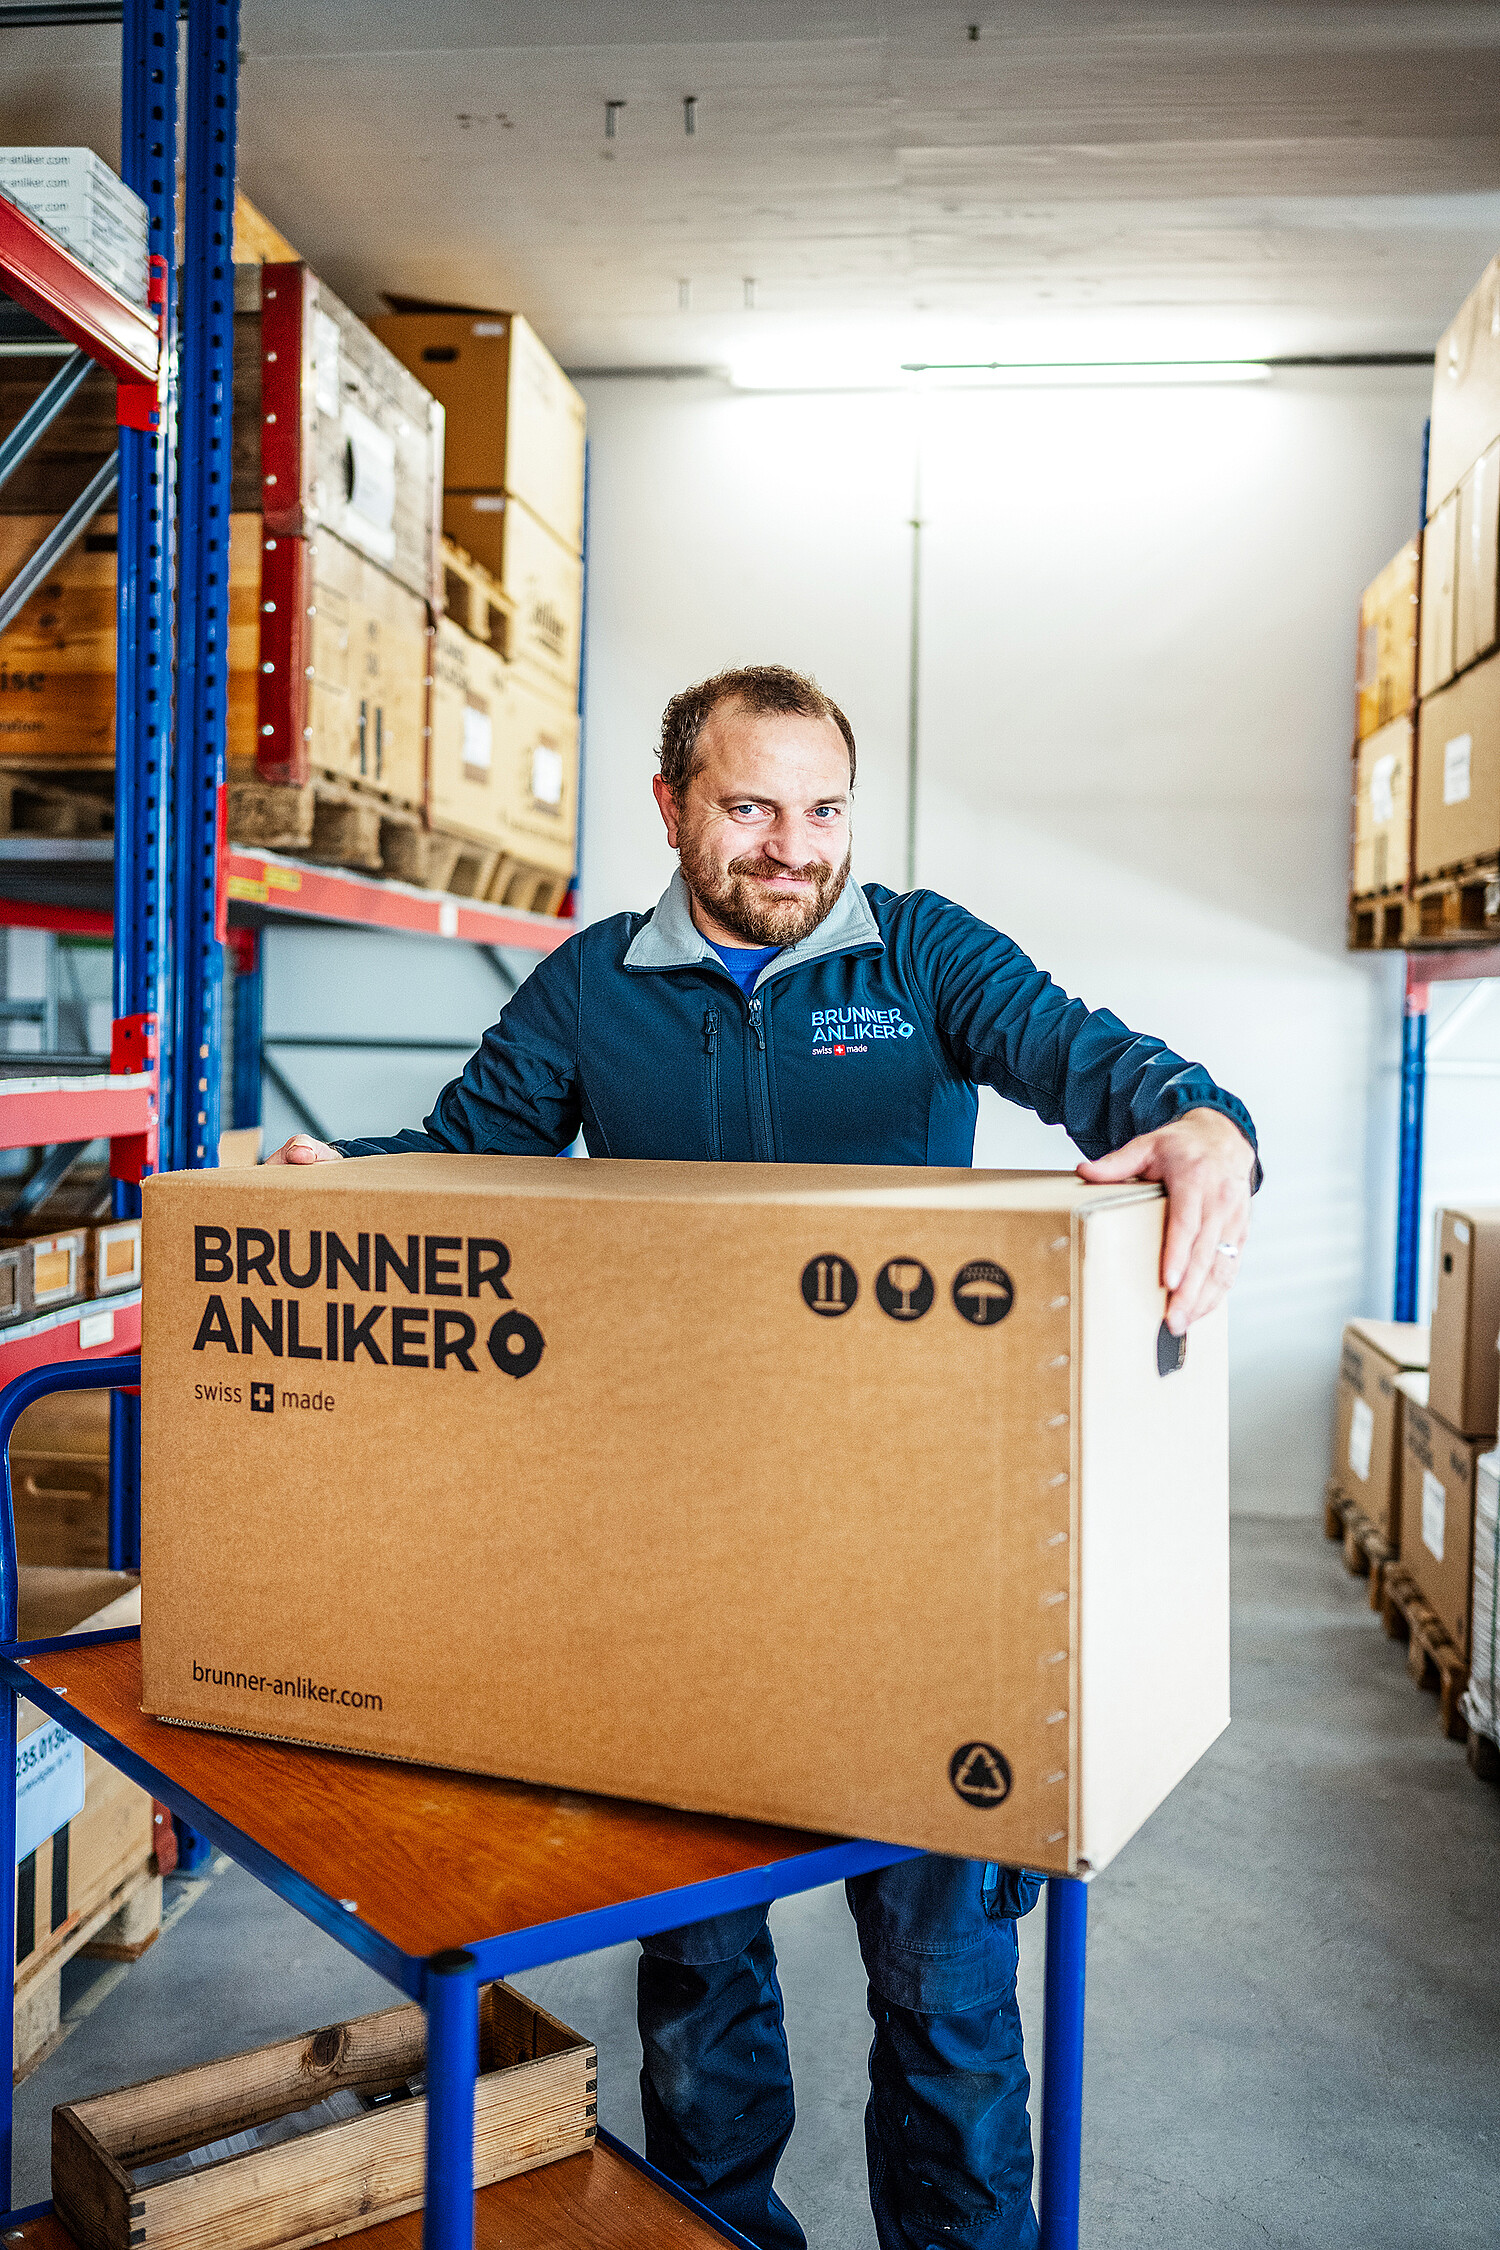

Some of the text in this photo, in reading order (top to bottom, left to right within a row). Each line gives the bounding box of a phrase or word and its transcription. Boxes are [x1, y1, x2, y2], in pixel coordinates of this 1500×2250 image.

[811, 1006, 903, 1026] BRUNNER
[812, 1023, 898, 1042] ANLIKER
[811, 1044, 868, 1055] swiss made
[194, 1225, 514, 1299] BRUNNER
[192, 1294, 480, 1372] ANLIKER
[194, 1382, 335, 1412] swiss made
[193, 1660, 383, 1711] brunner-anliker.com
